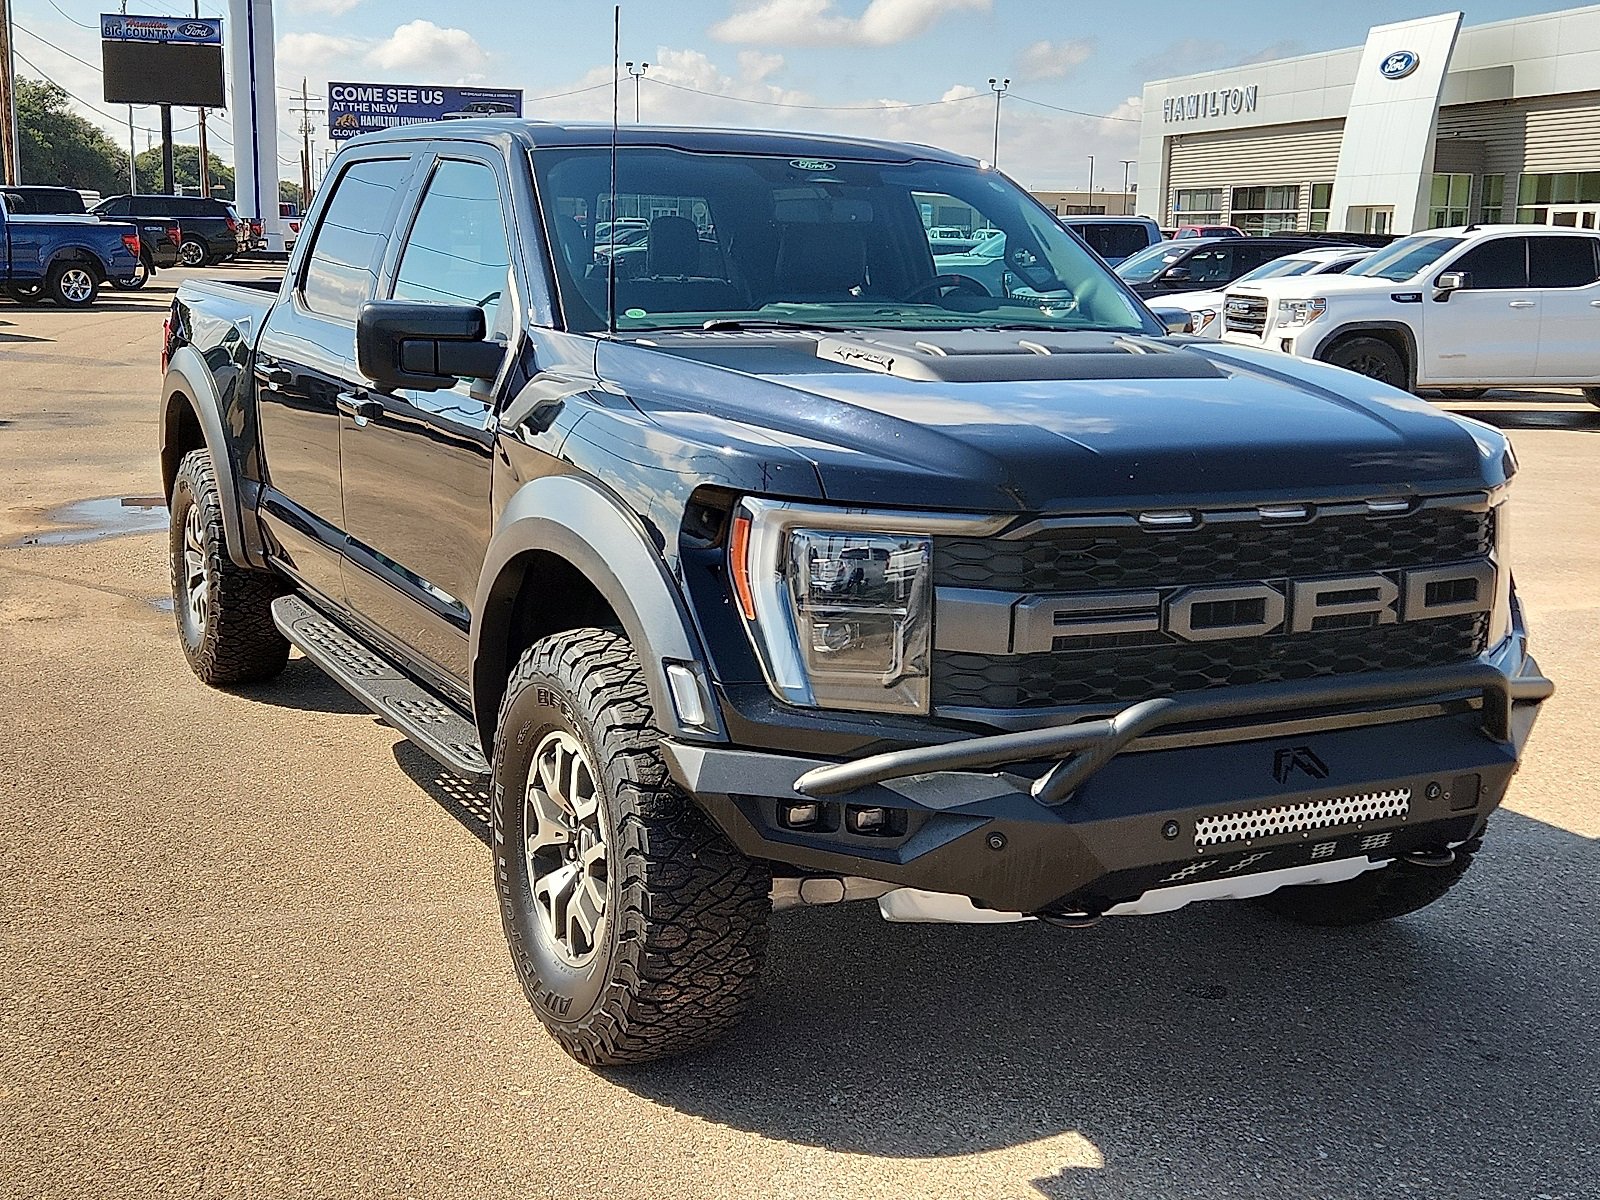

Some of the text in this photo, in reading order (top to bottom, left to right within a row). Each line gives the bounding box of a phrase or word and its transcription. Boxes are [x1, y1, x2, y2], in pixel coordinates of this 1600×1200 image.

[104, 27, 175, 39] BIG COUNTRY
[184, 23, 209, 36] Ford
[1384, 53, 1409, 73] Ford
[331, 86, 383, 102] COME
[386, 88, 418, 104] SEE
[421, 90, 444, 105] US
[1163, 84, 1258, 123] HAMILTON
[331, 101, 398, 113] AT THE NEW
[360, 114, 400, 127] HAMILTON
[1016, 557, 1496, 655] FORD
